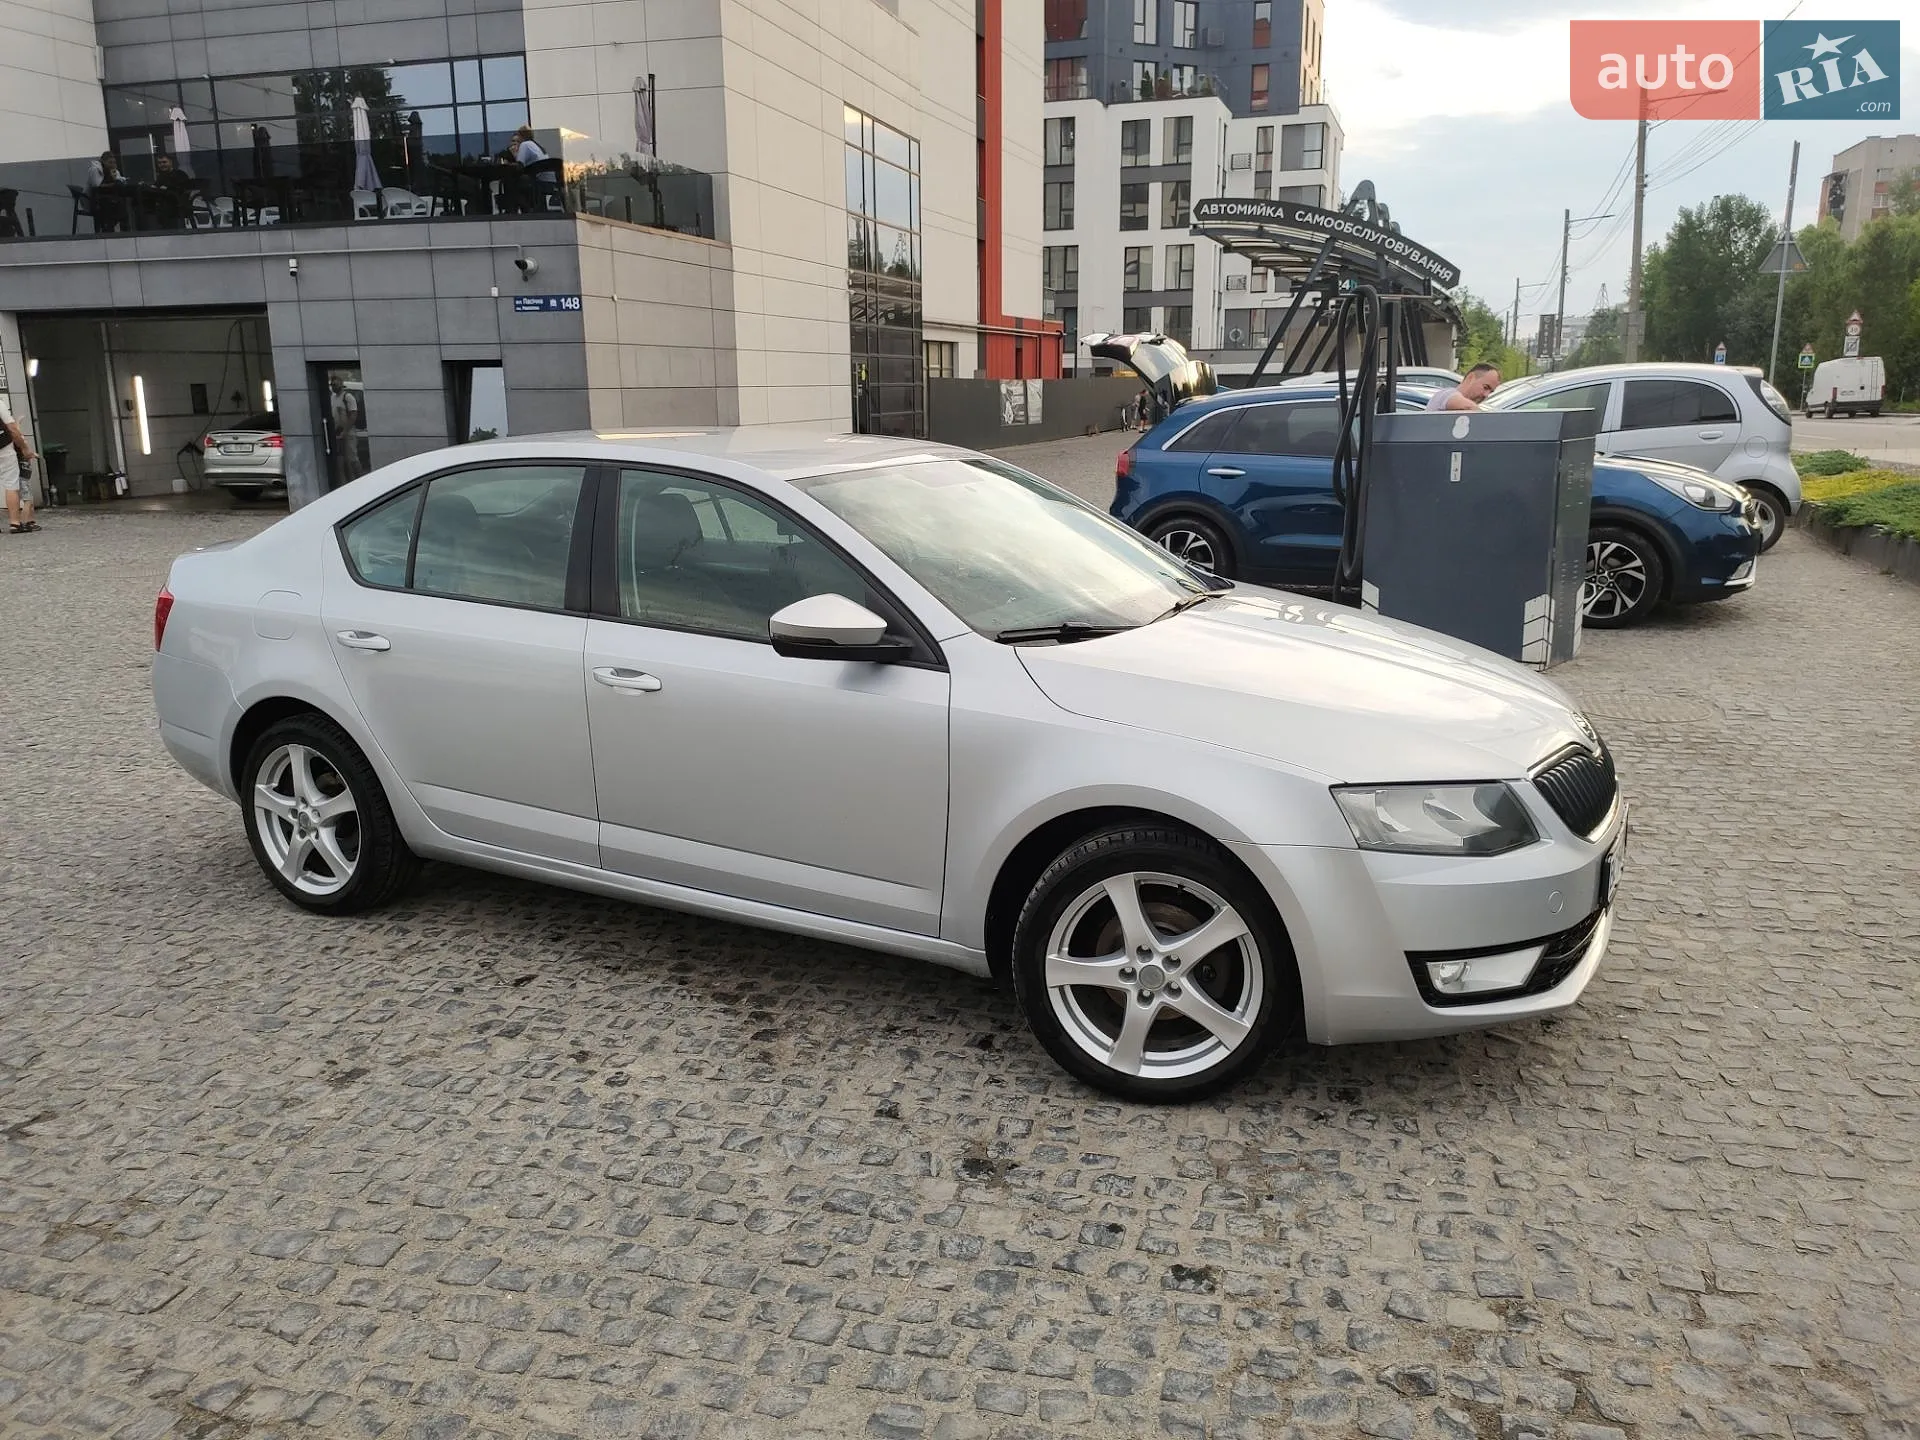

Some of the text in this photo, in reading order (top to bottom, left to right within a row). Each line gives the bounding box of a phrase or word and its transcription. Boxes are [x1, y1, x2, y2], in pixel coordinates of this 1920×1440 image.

[1200, 203, 1453, 281] АВТОМИЙКА САМООБСЛУГОВУВАННЯ
[560, 297, 580, 309] 148
